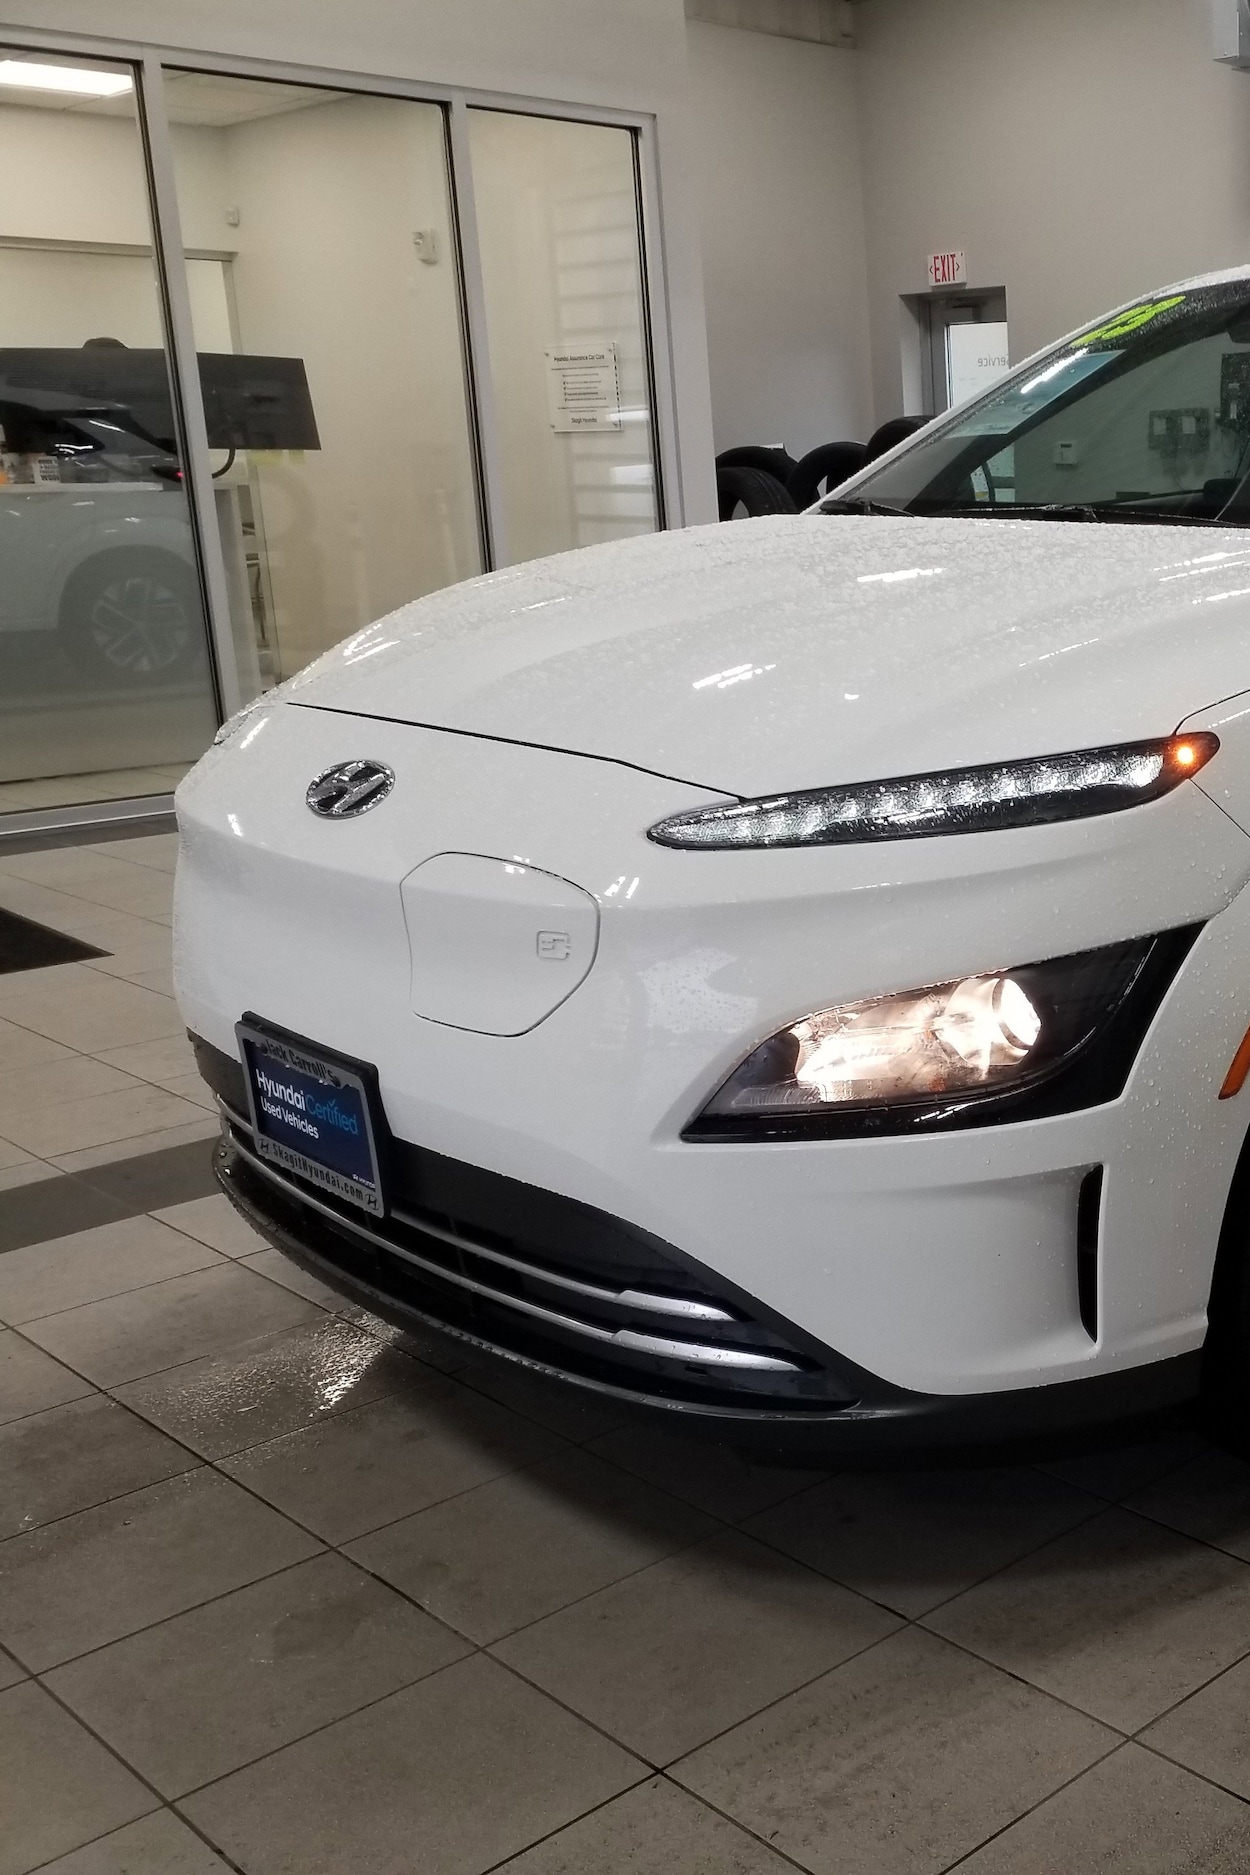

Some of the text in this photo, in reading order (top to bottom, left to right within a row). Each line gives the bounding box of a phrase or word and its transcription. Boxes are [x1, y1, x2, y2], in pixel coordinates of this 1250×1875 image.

[933, 253, 956, 283] EXIT
[256, 1068, 358, 1136] Hyundai Certified
[260, 1096, 320, 1139] Used Vehicles
[272, 1143, 364, 1201] SkagitHyundai.com
